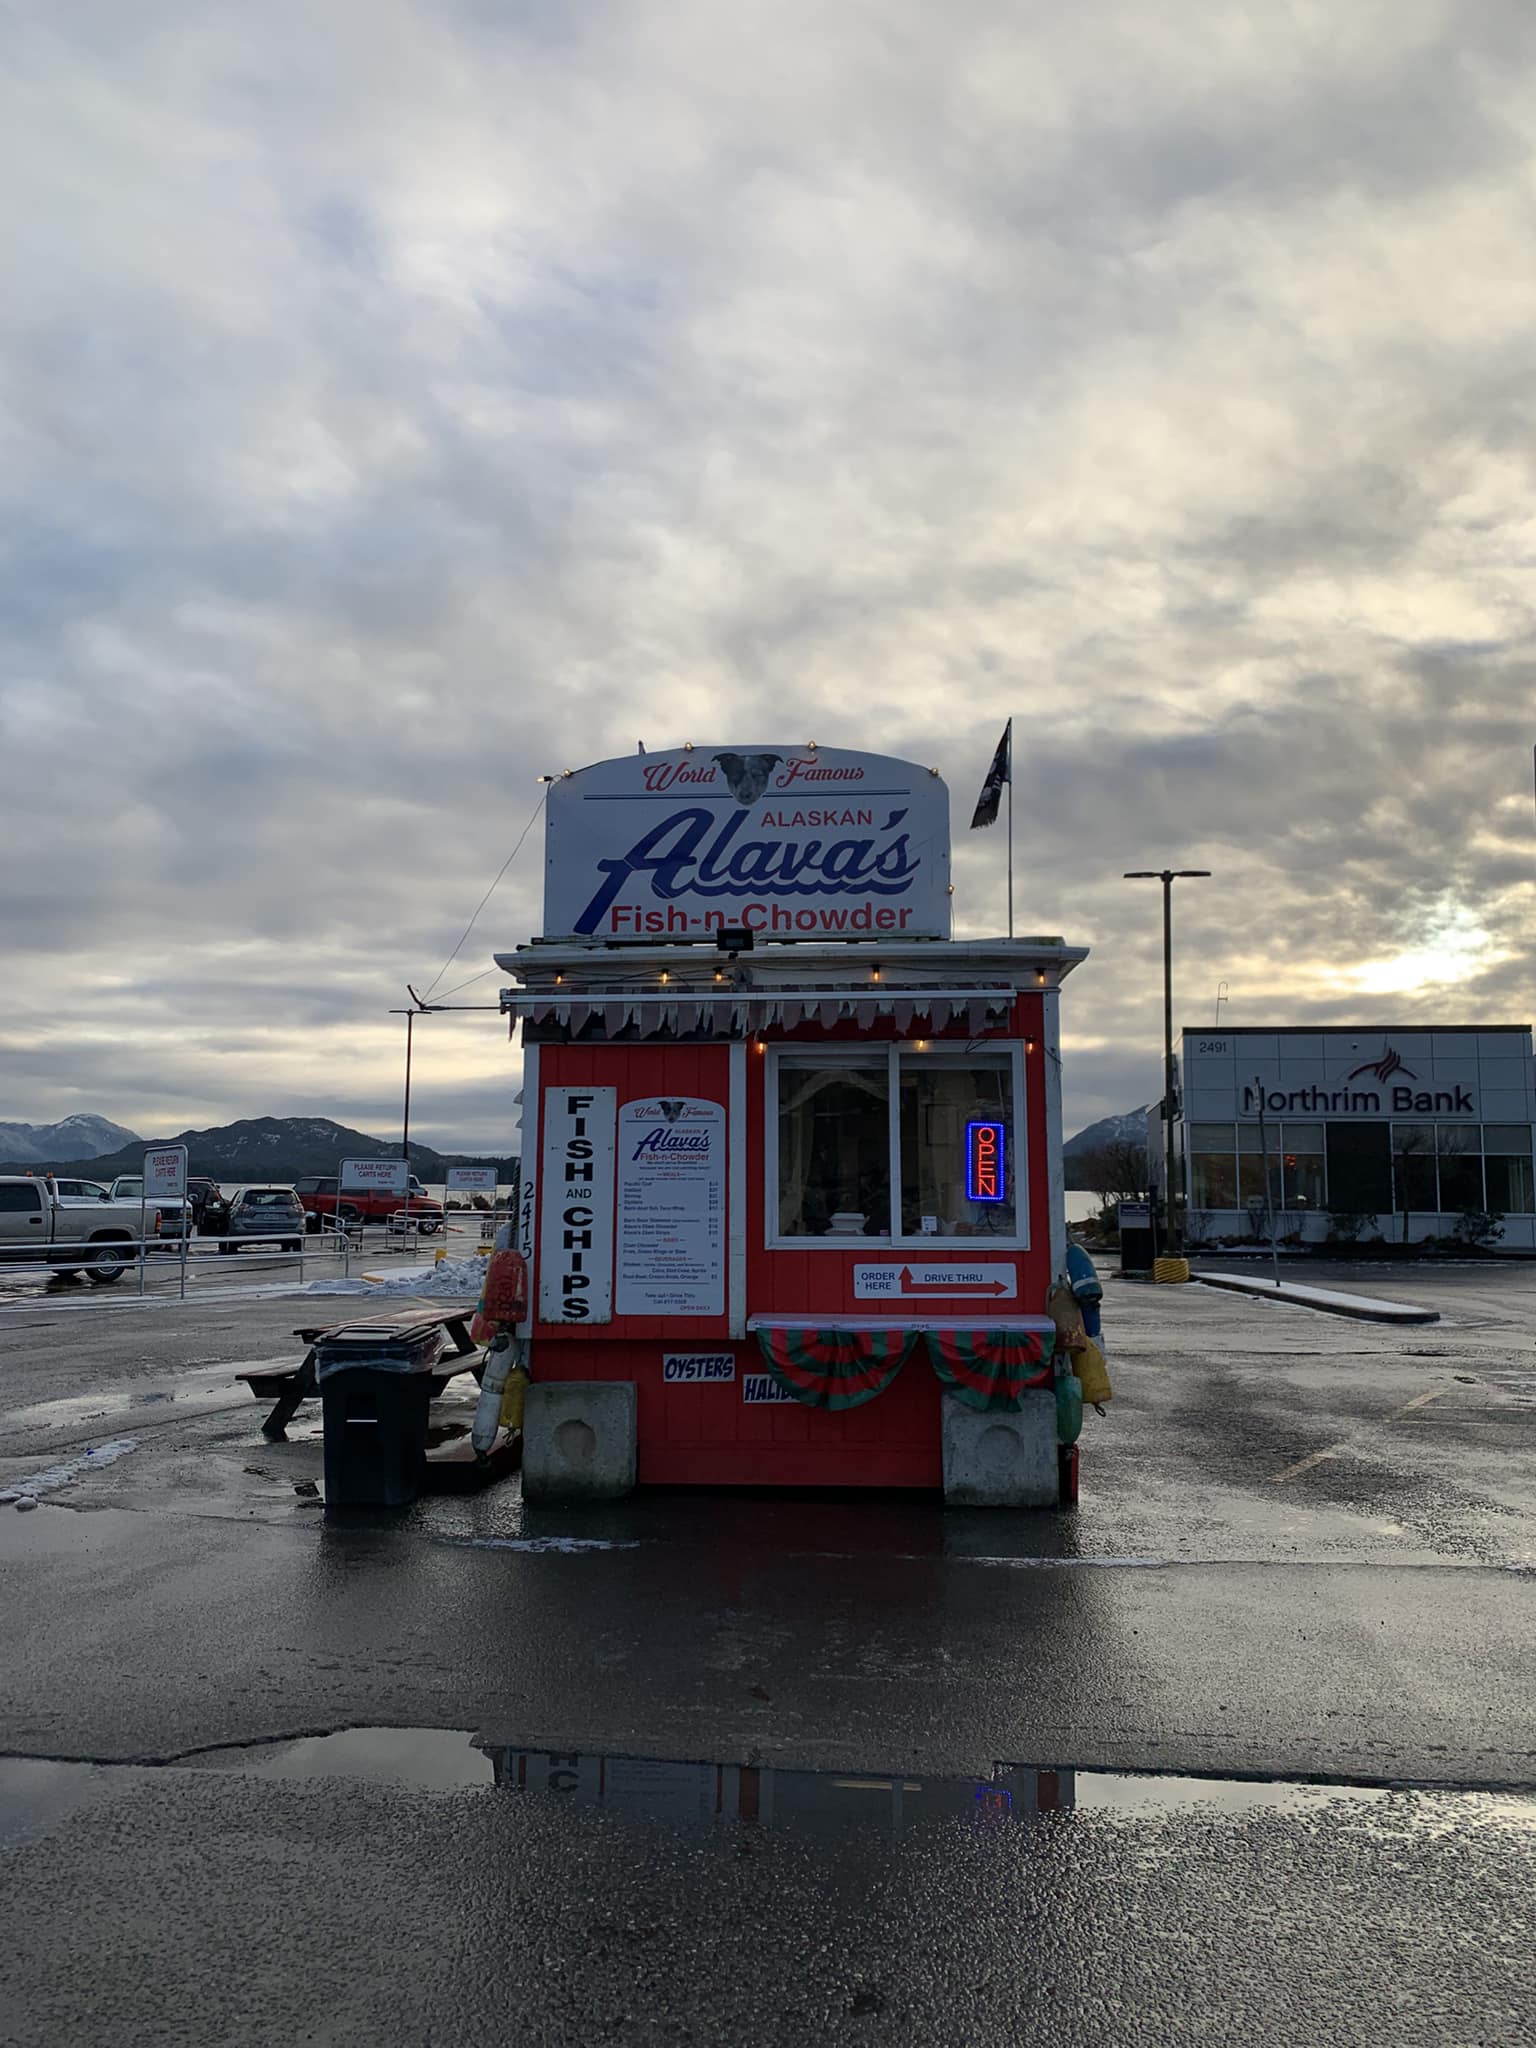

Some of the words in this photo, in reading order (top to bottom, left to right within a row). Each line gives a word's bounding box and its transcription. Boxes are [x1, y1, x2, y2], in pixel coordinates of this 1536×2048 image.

[643, 761, 716, 792] World
[776, 757, 864, 788] Famous
[761, 809, 872, 828] ALASKAN
[573, 807, 921, 935] Alava's
[611, 902, 914, 933] Fish-n-Chowder
[1199, 1041, 1227, 1053] 2491
[1243, 1085, 1380, 1113] Northrim
[1392, 1085, 1475, 1113] Bank
[565, 1095, 594, 1182] FISH
[632, 1128, 711, 1161] Alava's
[640, 1153, 709, 1161] Fish-n-Chowder
[978, 1127, 996, 1197] OPEN
[566, 1188, 592, 1199] AND
[562, 1206, 594, 1319] CHIPS
[861, 1272, 895, 1281] ORDER
[865, 1282, 892, 1290] HERE
[924, 1274, 953, 1282] DRIVE
[956, 1274, 983, 1282] THRU
[665, 1356, 733, 1380] OYSTERS
